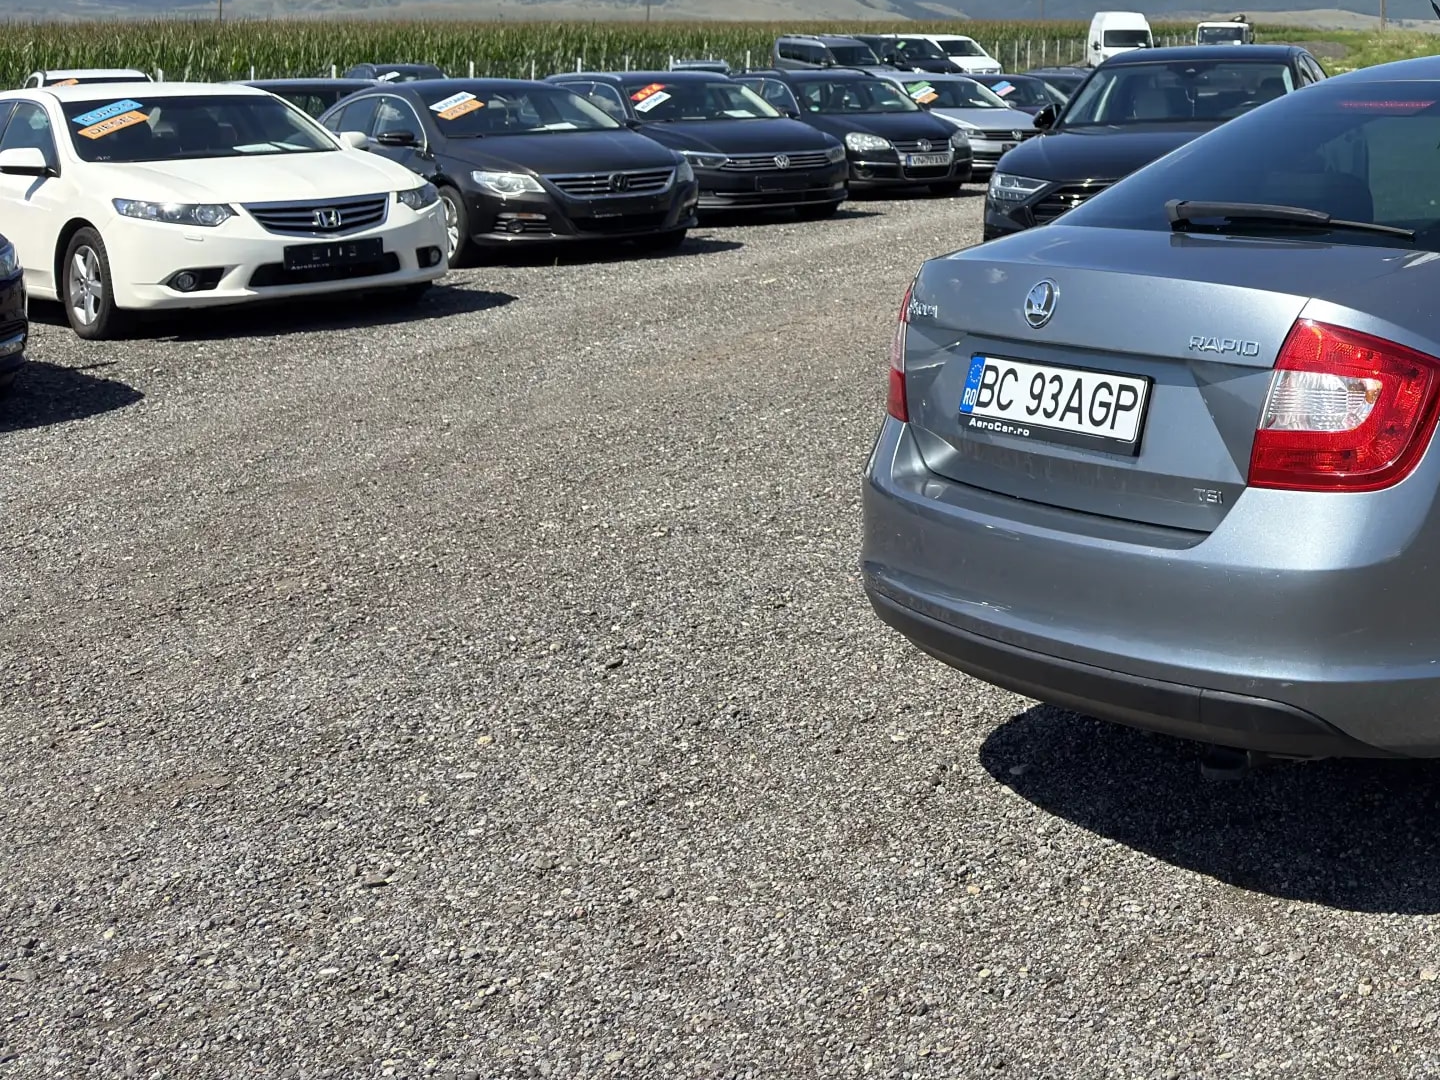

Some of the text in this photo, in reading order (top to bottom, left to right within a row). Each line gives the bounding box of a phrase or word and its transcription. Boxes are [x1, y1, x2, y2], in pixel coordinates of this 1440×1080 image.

[88, 115, 140, 135] DIESEL
[1188, 335, 1260, 357] RAPID
[963, 388, 977, 406] RO
[975, 364, 1139, 431] BC 93AGP
[969, 417, 1030, 437] AeroCar.ro
[1193, 487, 1224, 504] TSI
